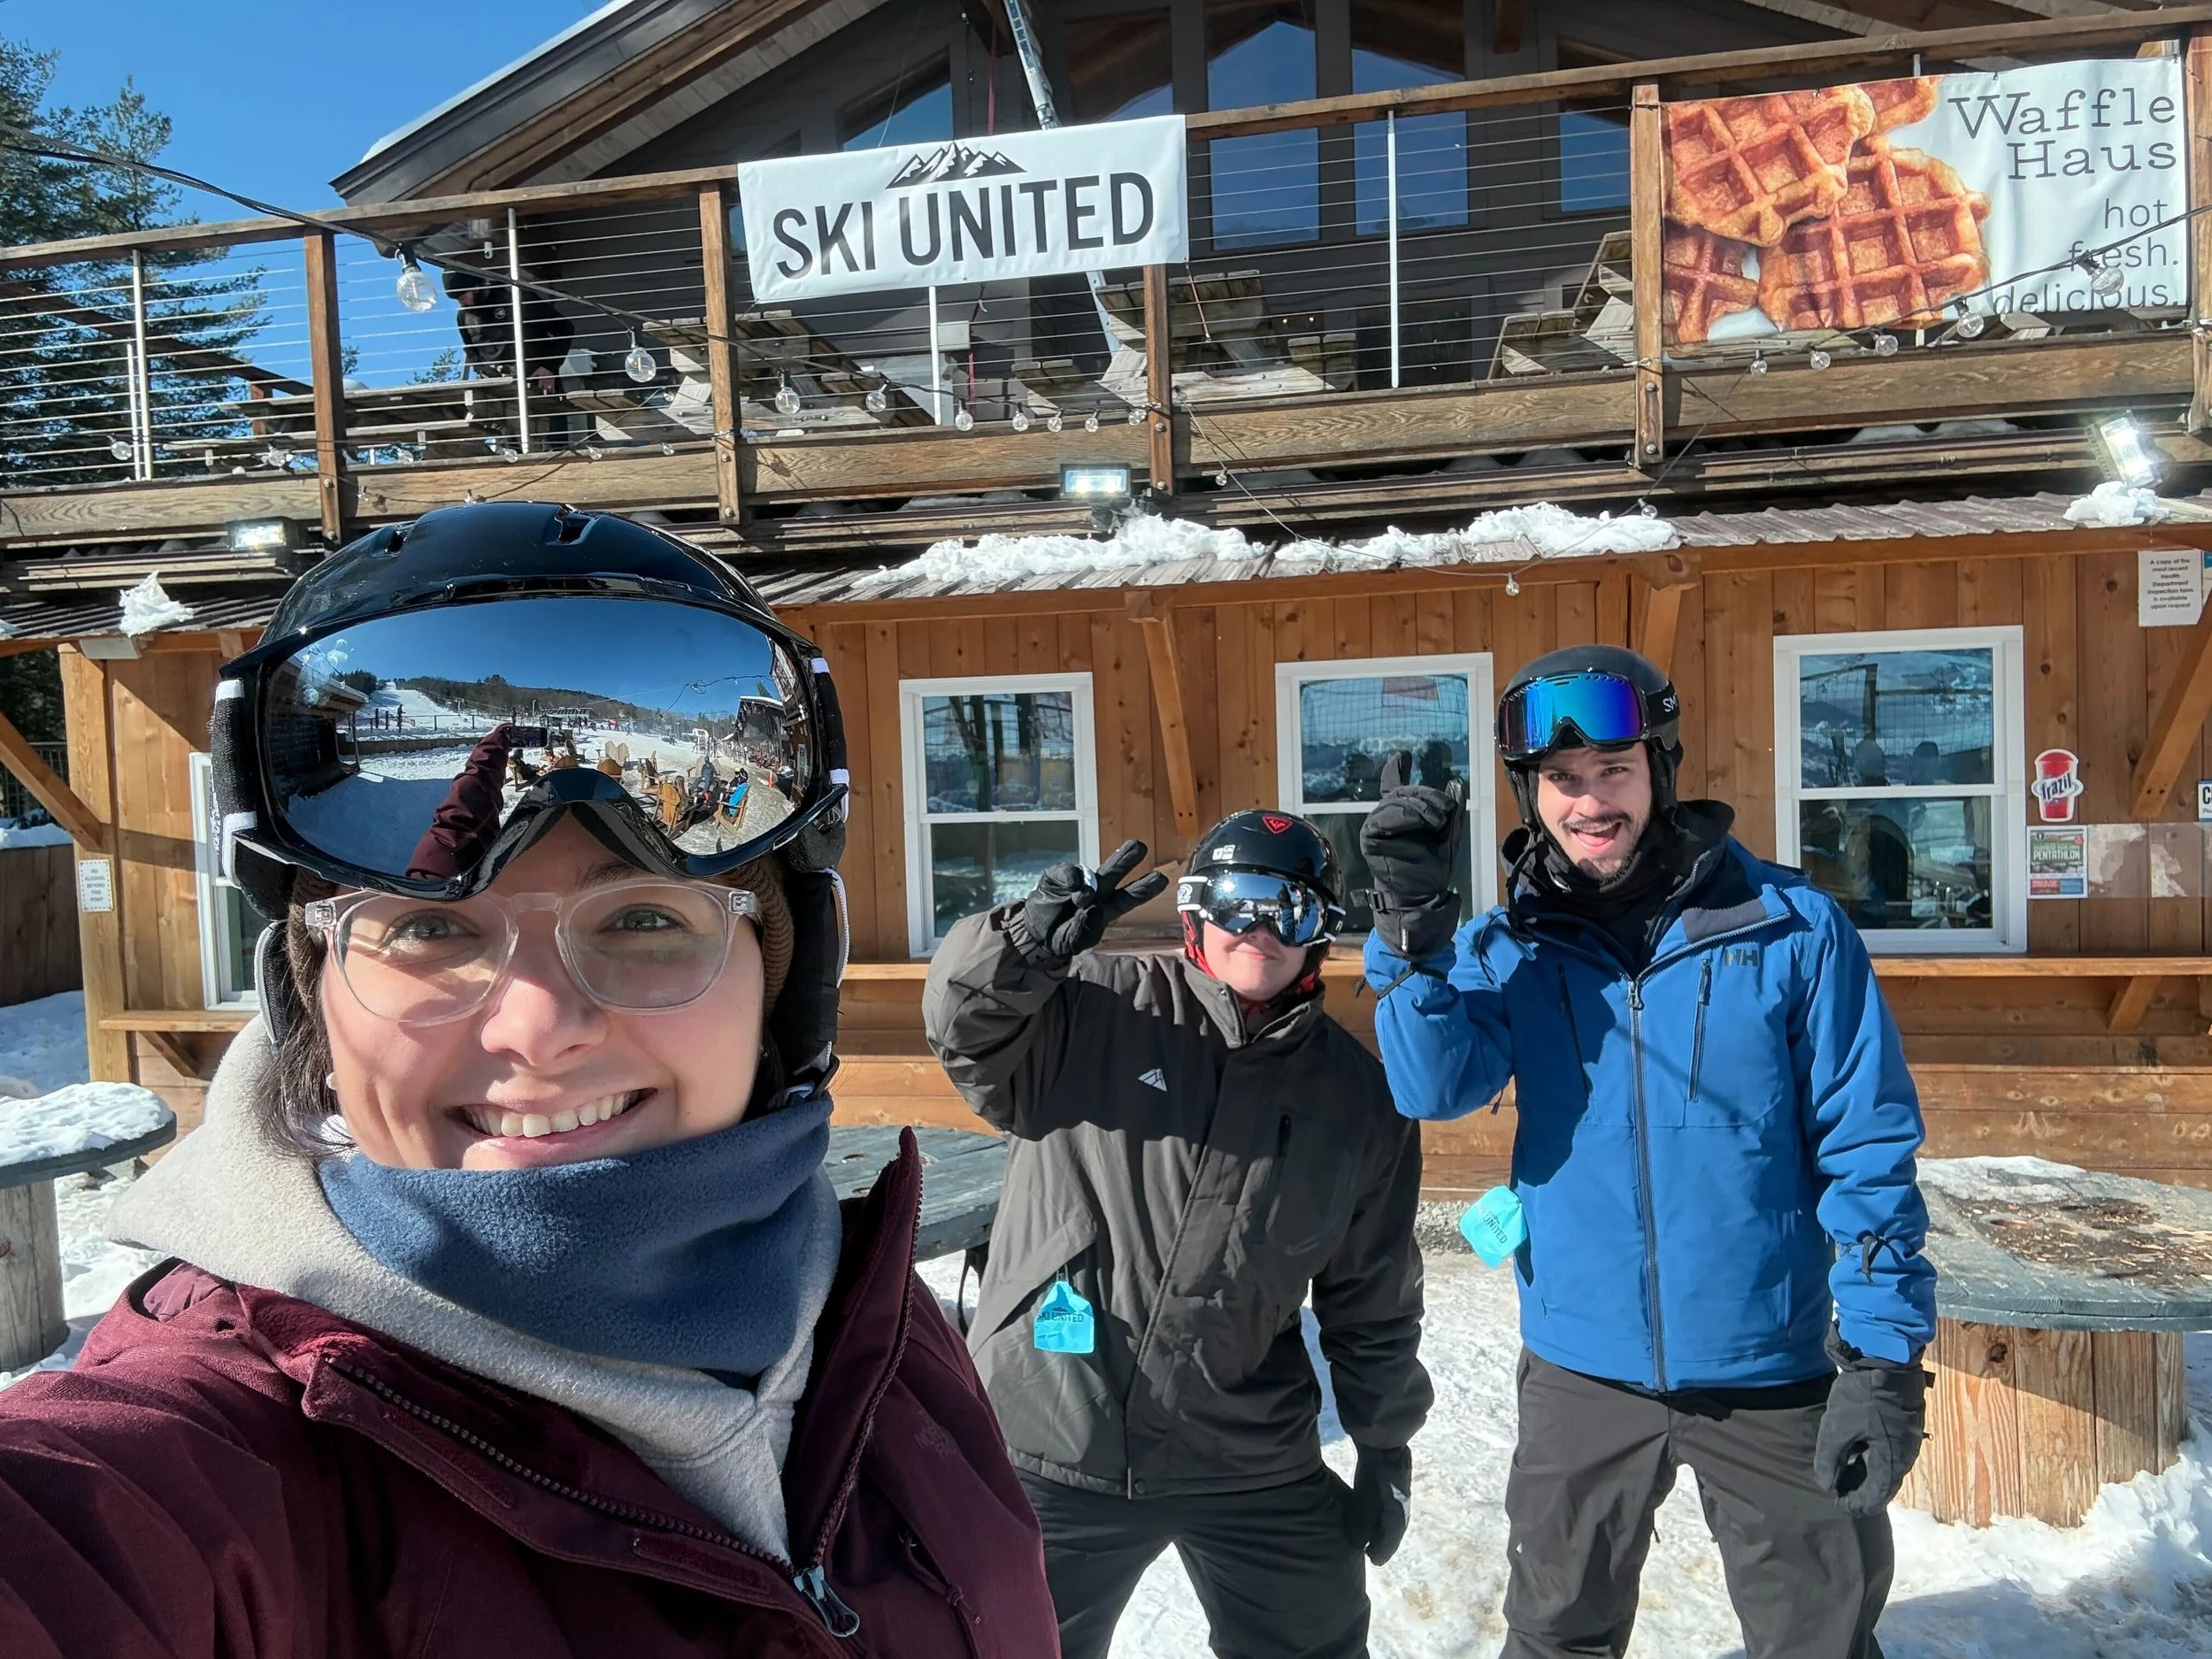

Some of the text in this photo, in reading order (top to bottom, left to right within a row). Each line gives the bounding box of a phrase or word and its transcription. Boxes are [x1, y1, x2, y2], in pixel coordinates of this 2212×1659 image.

[1947, 87, 2176, 140] Waffle
[2006, 139, 2177, 180] Haus
[772, 171, 1154, 280] SKI UNITED
[2068, 236, 2179, 273] fesh.
[2041, 772, 2071, 801] frazil
[2032, 849, 2081, 861] PENTATHLON
[1483, 1213, 1508, 1244] UNITED
